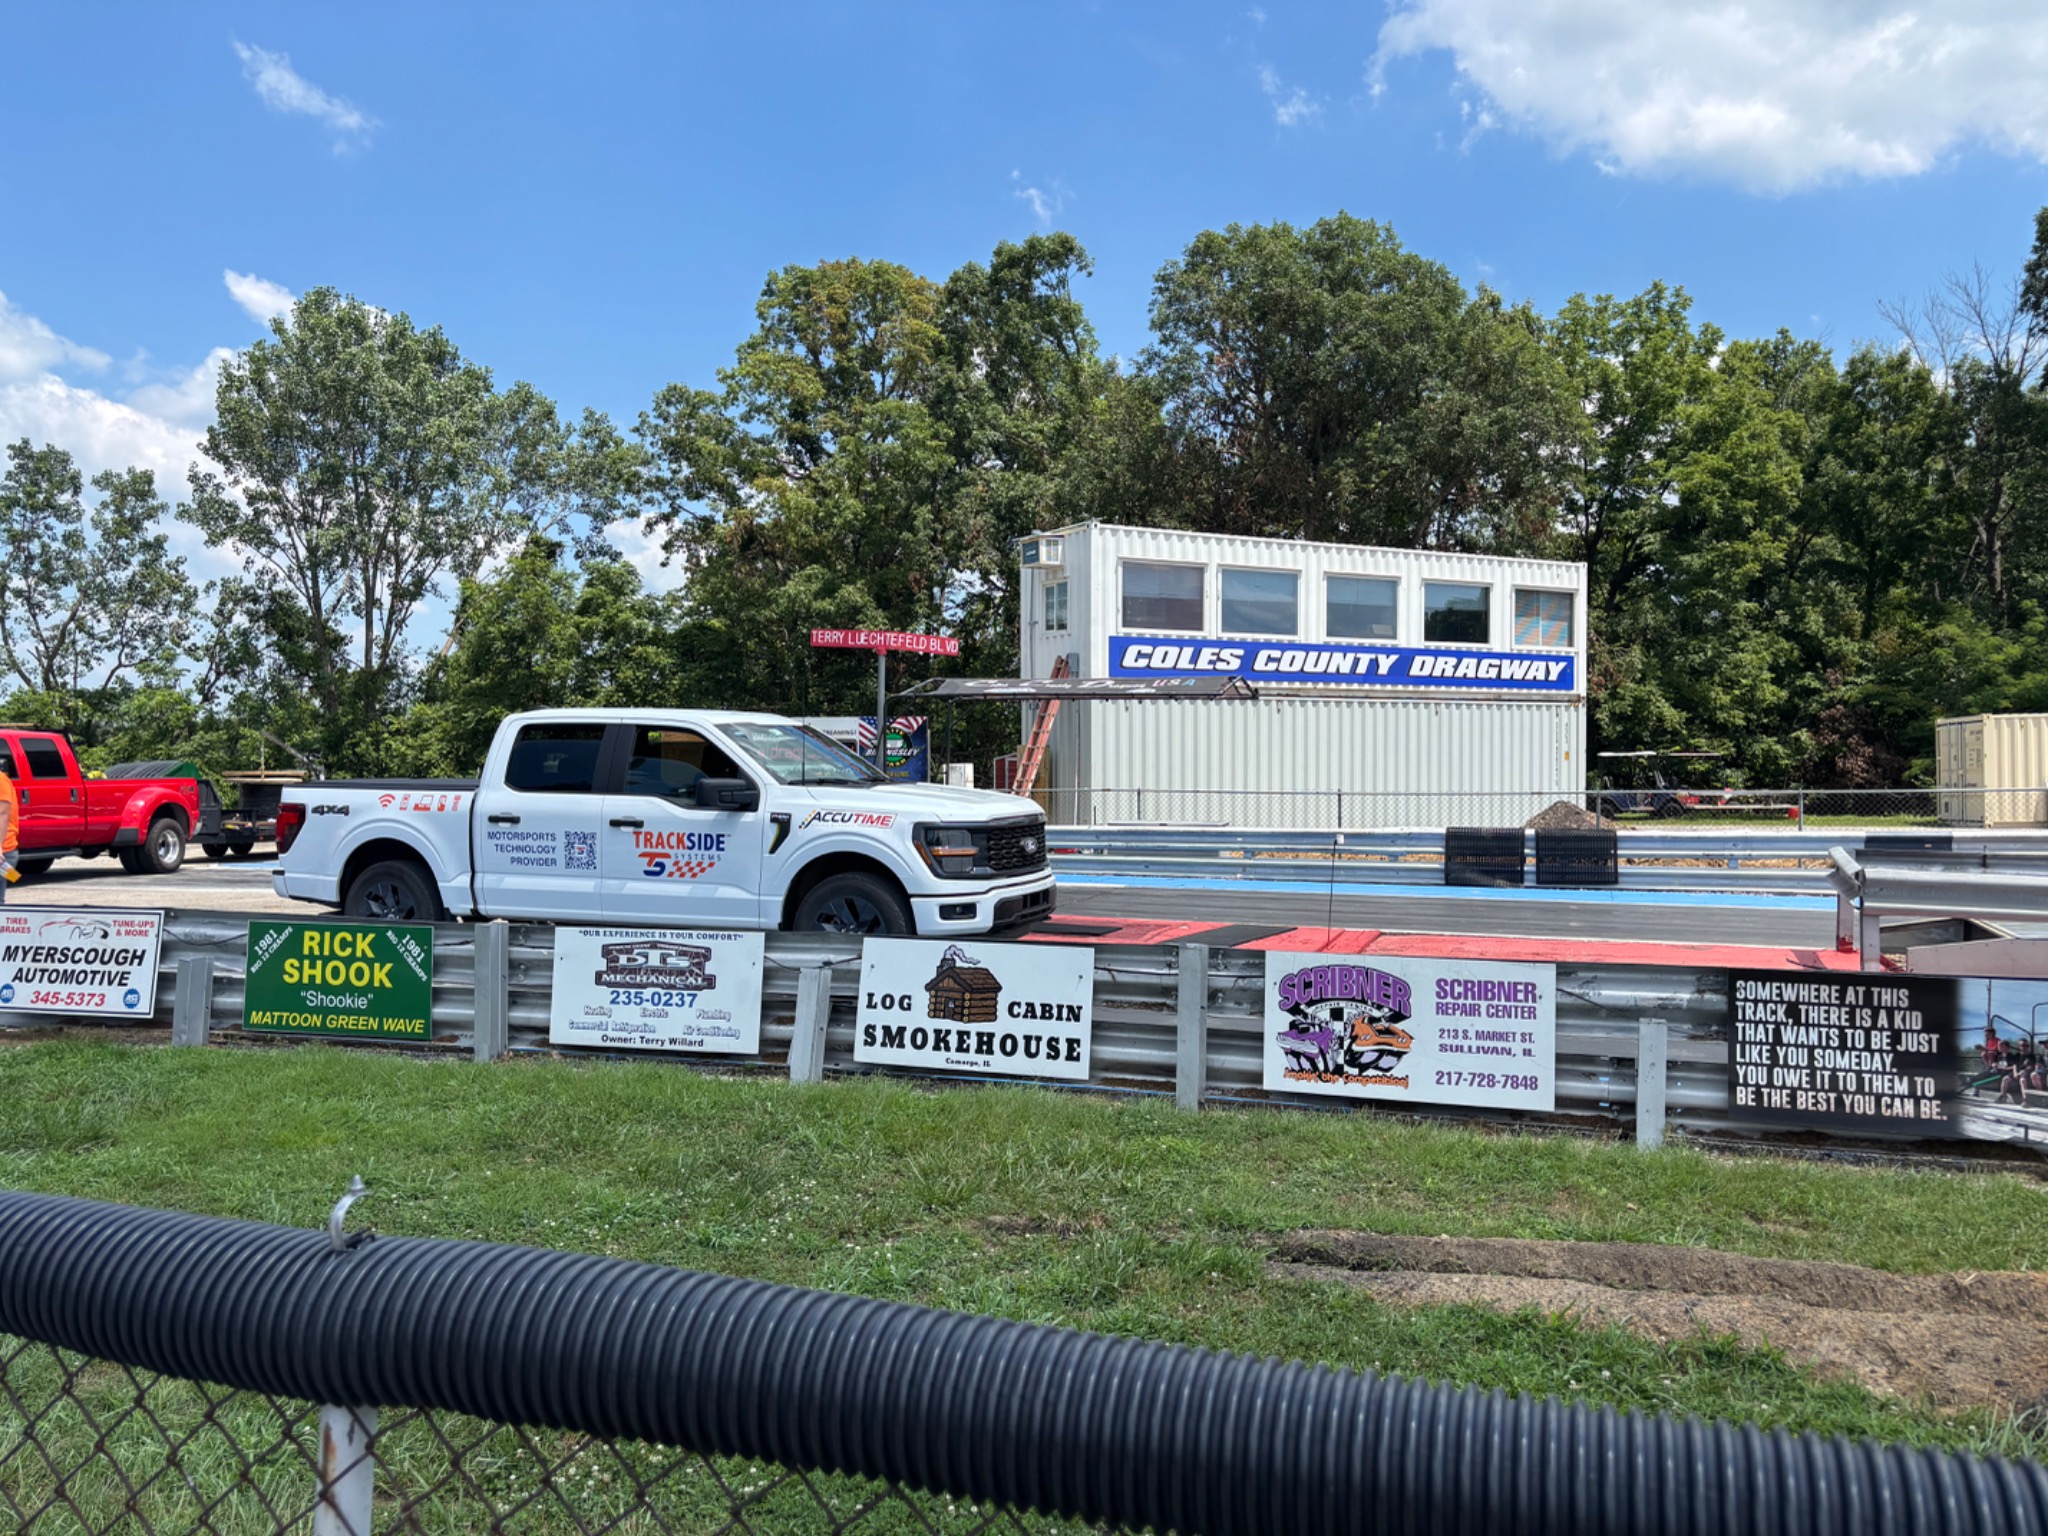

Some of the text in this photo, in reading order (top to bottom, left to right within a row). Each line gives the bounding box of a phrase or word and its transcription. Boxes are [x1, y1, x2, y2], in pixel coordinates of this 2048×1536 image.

[811, 630, 846, 643] TERRY
[848, 631, 927, 649] LUECHTEFELD
[1120, 644, 1568, 682] COLES COUNTY DRAGWAY
[803, 811, 893, 829] ACCUTIME
[487, 831, 557, 842] MOTORSPORTS
[632, 831, 726, 852] TRACKSIDE
[494, 843, 557, 855] TECHNOLOGY
[674, 852, 722, 862] SYSTEMS
[510, 856, 557, 867] PROVIDER
[0, 925, 31, 935] BRAKES
[5, 916, 28, 925] TIRES
[112, 919, 156, 929] TUNE-UPS
[116, 929, 149, 938] & MORE
[254, 929, 278, 956] 1981
[268, 925, 294, 954] CHAMPS
[603, 930, 657, 939] EXPERIENCE
[658, 931, 668, 939] IS
[670, 932, 695, 940] YOUR
[303, 930, 376, 958] RICK
[402, 934, 425, 964] 1981
[2, 945, 147, 967] MYERSCOUGH
[283, 958, 394, 989] SHOOK
[403, 951, 428, 982] CHAMPS
[11, 967, 132, 987] AUTOMOTIVE
[602, 973, 704, 988] MECHANICAL
[30, 990, 107, 1008] 345-5373
[300, 990, 373, 1009] "Shookie"
[609, 990, 698, 1008] 235-0237
[1278, 964, 1412, 1017] SCRIBNER
[1435, 977, 1537, 1004] SCRIBNER
[1736, 980, 1910, 1008] SOMEWHERE AT THIS
[865, 992, 1083, 1023] LOG CABIN
[1435, 1001, 1537, 1020] REPAIR CENTER
[1736, 1001, 1923, 1031] TRACK, THERE IS A KID
[250, 1010, 426, 1034] MATTOON GREEN WAVE
[601, 1034, 704, 1048] Owner: Terry Willard
[863, 1023, 1082, 1062] SMOKEHOUSE
[1438, 1027, 1536, 1044] 213 S. MARKET ST.
[1736, 1022, 1940, 1054] THAT WANTS TO BE JUST
[1438, 1043, 1537, 1058] SULLIVAN, IL
[1736, 1043, 1898, 1073] LIKE YOU SOMEDAY.
[945, 1057, 992, 1068] Camargo, IL
[1435, 1070, 1539, 1091] 217-728-7848
[1736, 1065, 1936, 1098] YOU OWE IT TO THEM TO
[1736, 1086, 1949, 1121] BE THE BEST YOU CAN BE.
